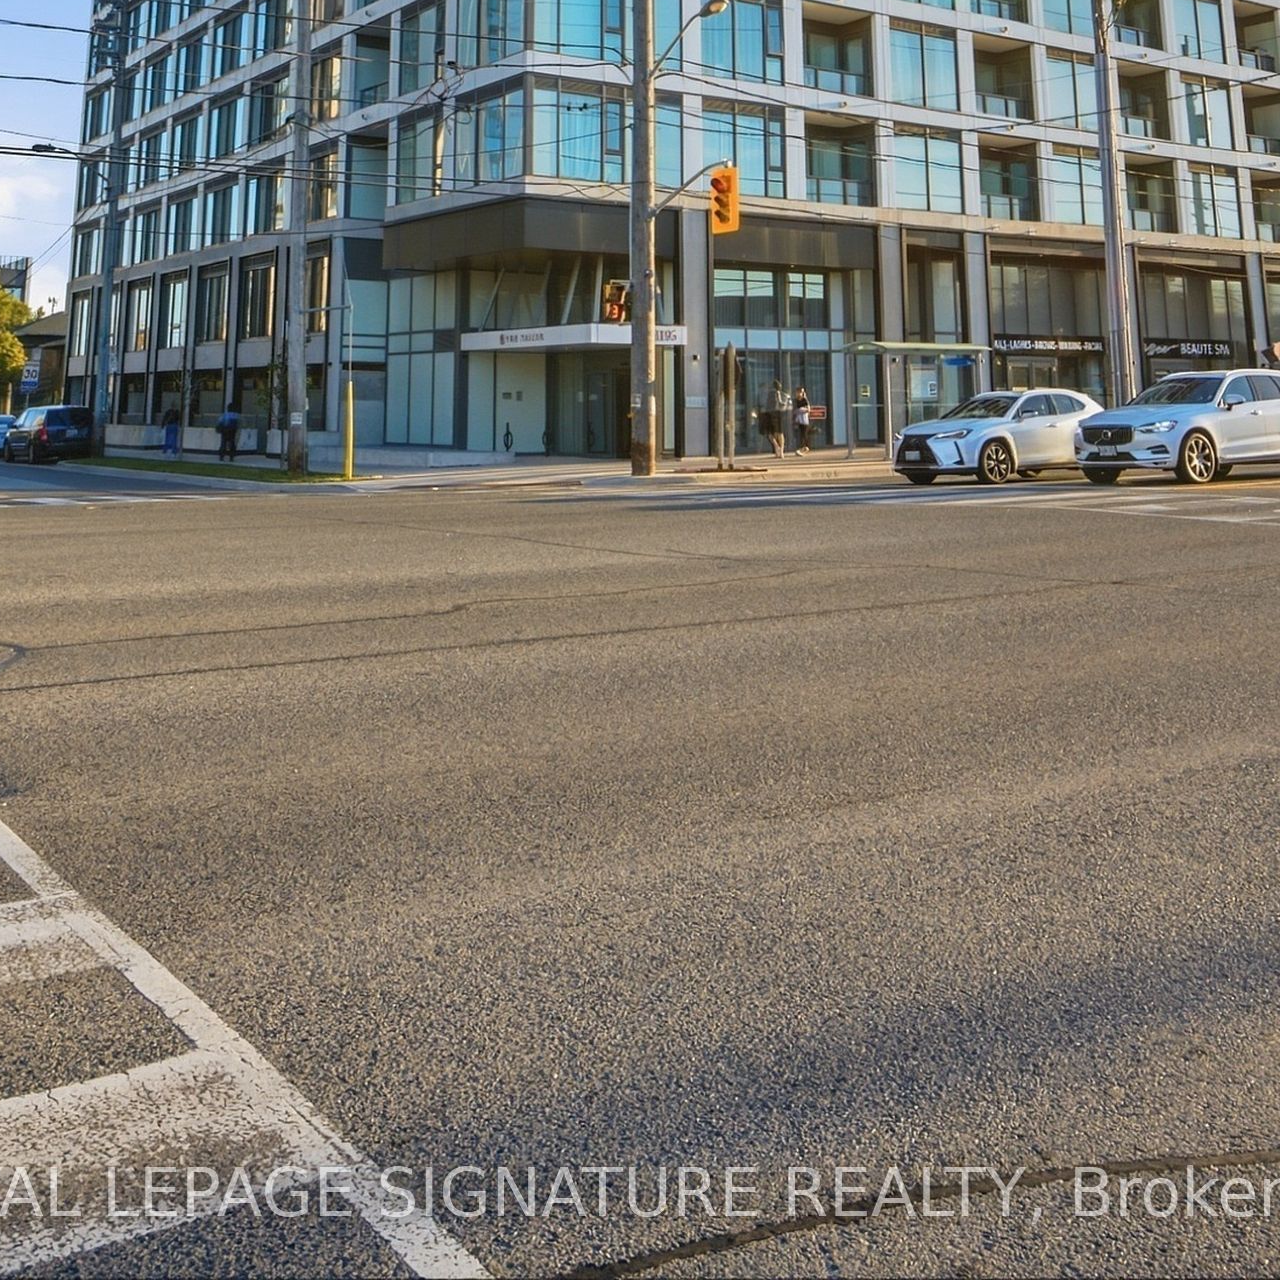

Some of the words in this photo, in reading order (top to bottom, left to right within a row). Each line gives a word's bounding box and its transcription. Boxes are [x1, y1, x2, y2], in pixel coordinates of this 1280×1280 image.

[1180, 343, 1214, 355] BEAUTE
[1214, 344, 1230, 355] SPA
[24, 369, 38, 379] 30
